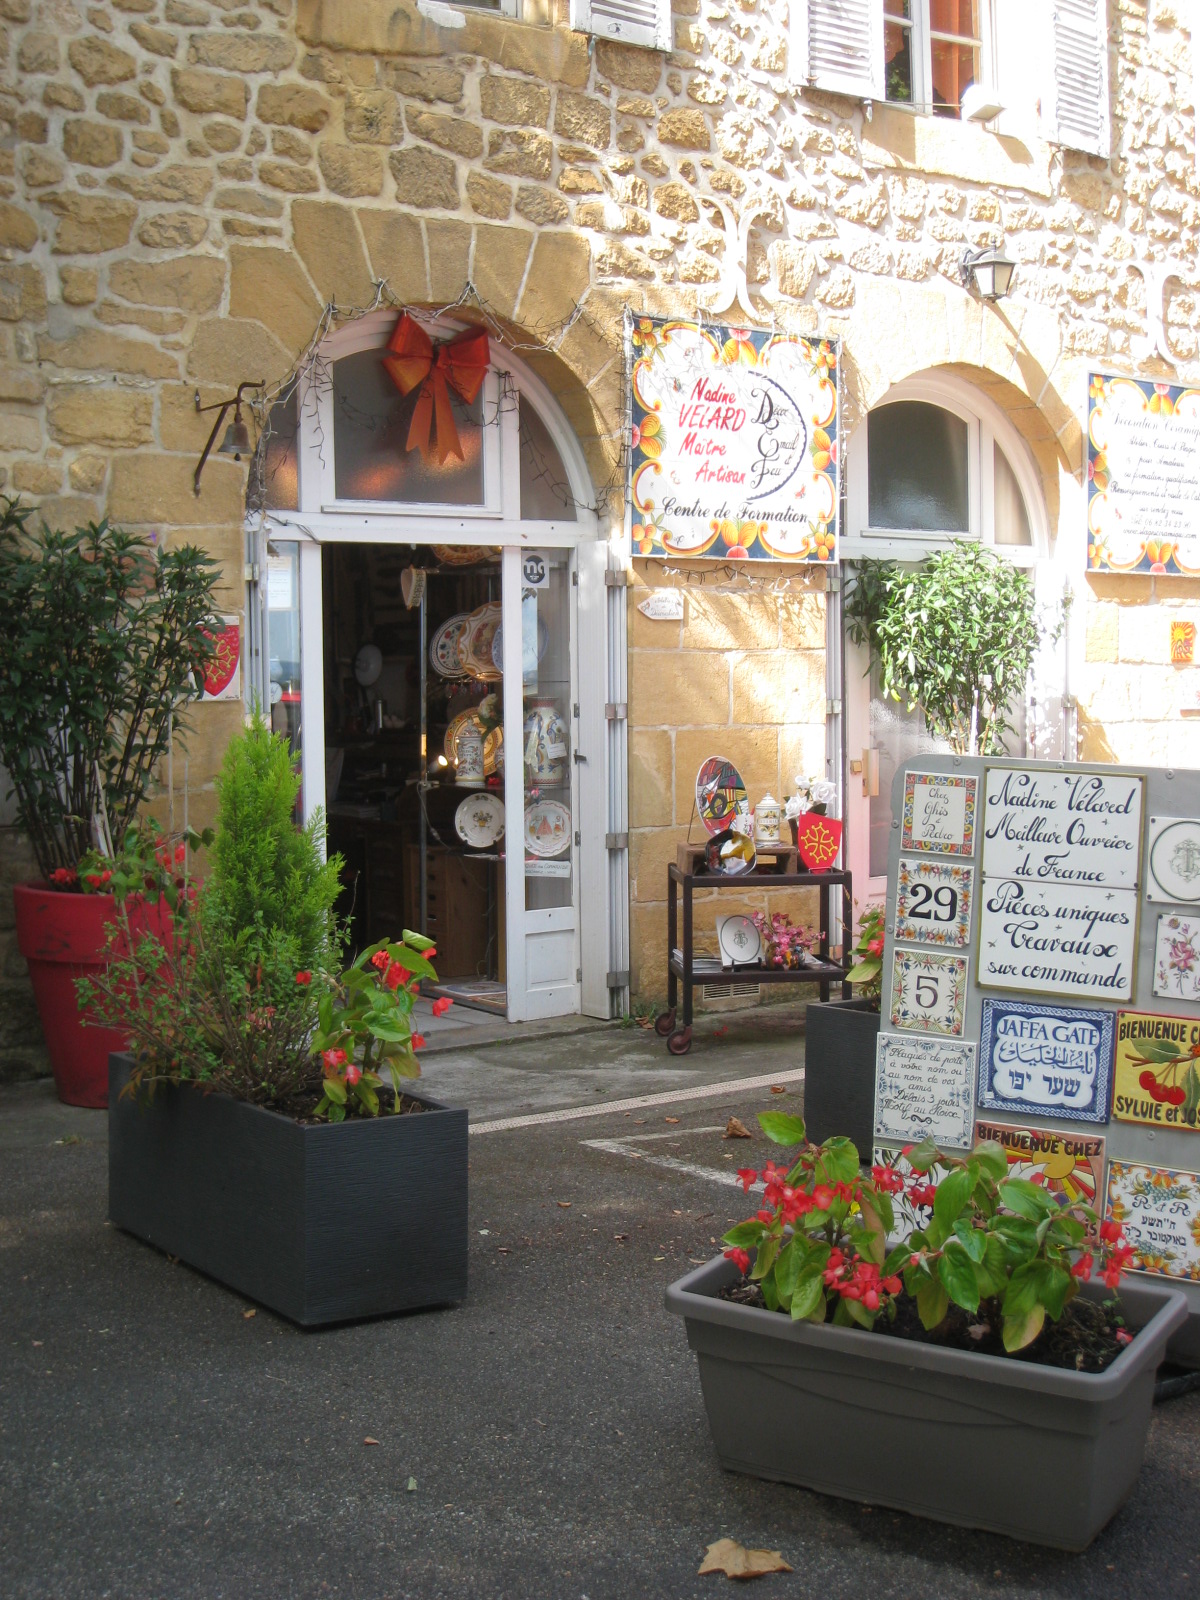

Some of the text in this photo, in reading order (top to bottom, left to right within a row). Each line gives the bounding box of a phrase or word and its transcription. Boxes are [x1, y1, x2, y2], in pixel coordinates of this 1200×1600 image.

[690, 377, 736, 405] Nadine
[678, 403, 746, 432] VELARD
[695, 460, 746, 484] Artisan
[661, 496, 808, 523] Centre de Formation
[928, 787, 949, 805] Chez
[988, 772, 1137, 814] Nadine Vélard
[1013, 850, 1106, 882] de France
[908, 883, 957, 922] 29
[1052, 904, 1130, 938] uniques
[1003, 920, 1118, 958] Travaux
[985, 961, 1129, 989] sur commande
[915, 975, 939, 1009] 5
[998, 1018, 1098, 1046] JAFFA GATE
[888, 1047, 963, 1067] Plaques de porte
[901, 1062, 923, 1070] votre
[927, 1065, 949, 1074] nom
[950, 1068, 963, 1076] ou
[903, 1074, 923, 1082] nom
[927, 1074, 938, 1083] de
[908, 1083, 932, 1092] amis
[1008, 1069, 1081, 1098] שער יפו
[914, 1105, 925, 1114] au
[926, 1093, 935, 1104] 3
[936, 1097, 960, 1107] jours
[1165, 1106, 1180, 1123] et
[1064, 1139, 1103, 1156] CHEZ
[1132, 1194, 1152, 1210] R
[1169, 1201, 1191, 1217] R
